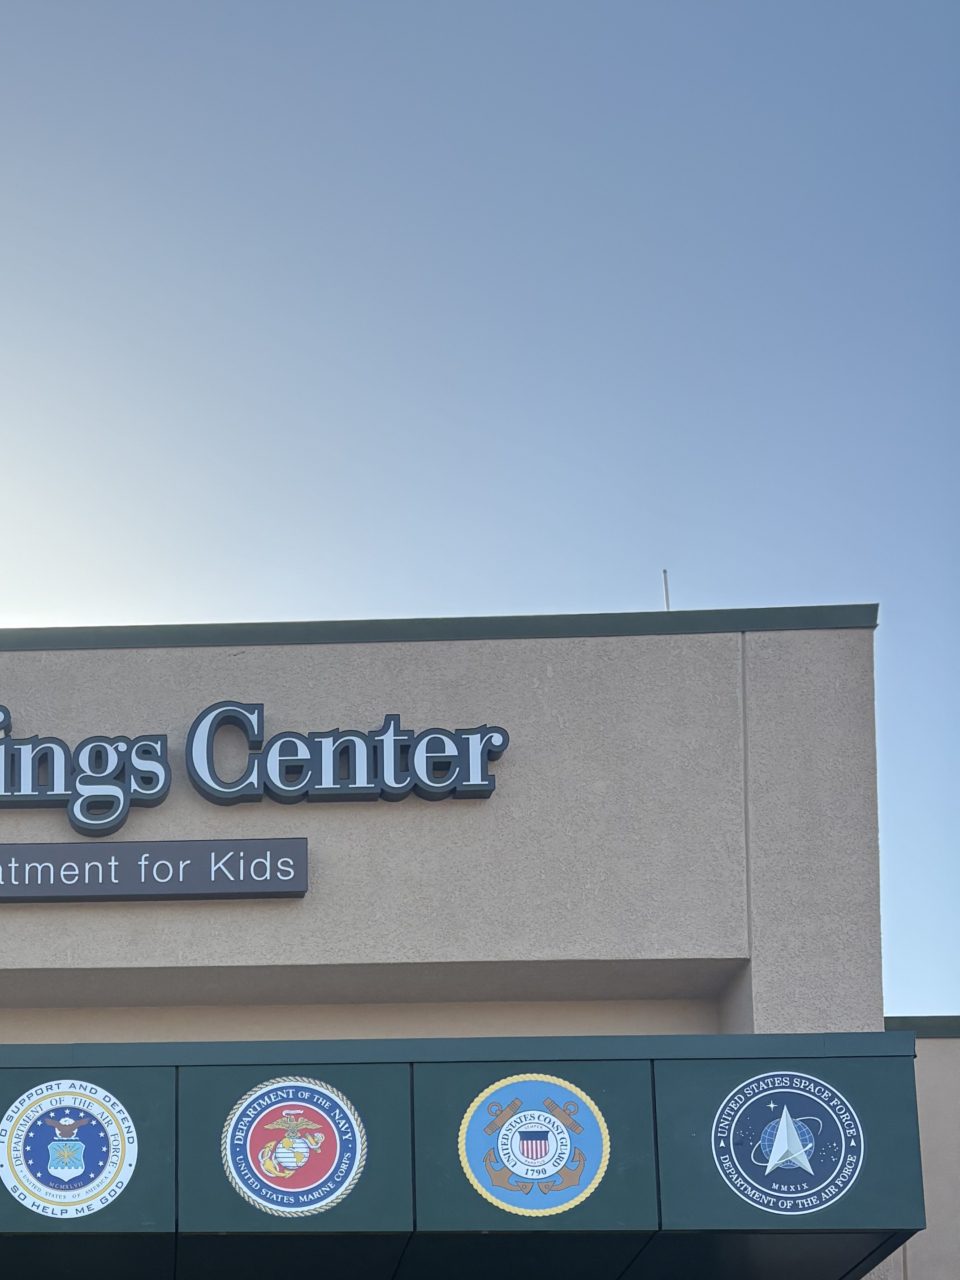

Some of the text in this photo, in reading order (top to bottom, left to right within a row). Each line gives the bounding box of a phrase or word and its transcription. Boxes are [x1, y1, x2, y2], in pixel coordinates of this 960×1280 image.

[187, 702, 508, 797] Center
[140, 852, 191, 884] for
[210, 850, 296, 882] Kids
[6, 1082, 62, 1123] SUPPORT
[68, 1082, 98, 1095] AND
[102, 1094, 135, 1145] DEFEND
[12, 1097, 121, 1169] DEPARTMENT OF THE AIR FORCE
[234, 1088, 353, 1145] DEPARTMENT OF THE NAVY
[718, 1077, 857, 1138] UNITED STATES SPACE FORCE
[501, 1113, 569, 1169] UNITED STATES COAST GUARD
[10, 1181, 124, 1216] SO HELP ME GOD
[23, 1174, 42, 1193] UNITED
[45, 1191, 67, 1200] STATES
[85, 1176, 109, 1195] AMERICA
[236, 1152, 352, 1204] UNITED STATES MARINE CORPS
[524, 1167, 547, 1177] 1790
[720, 1154, 857, 1209] DEPARTMENT OF THE AIR FORCE
